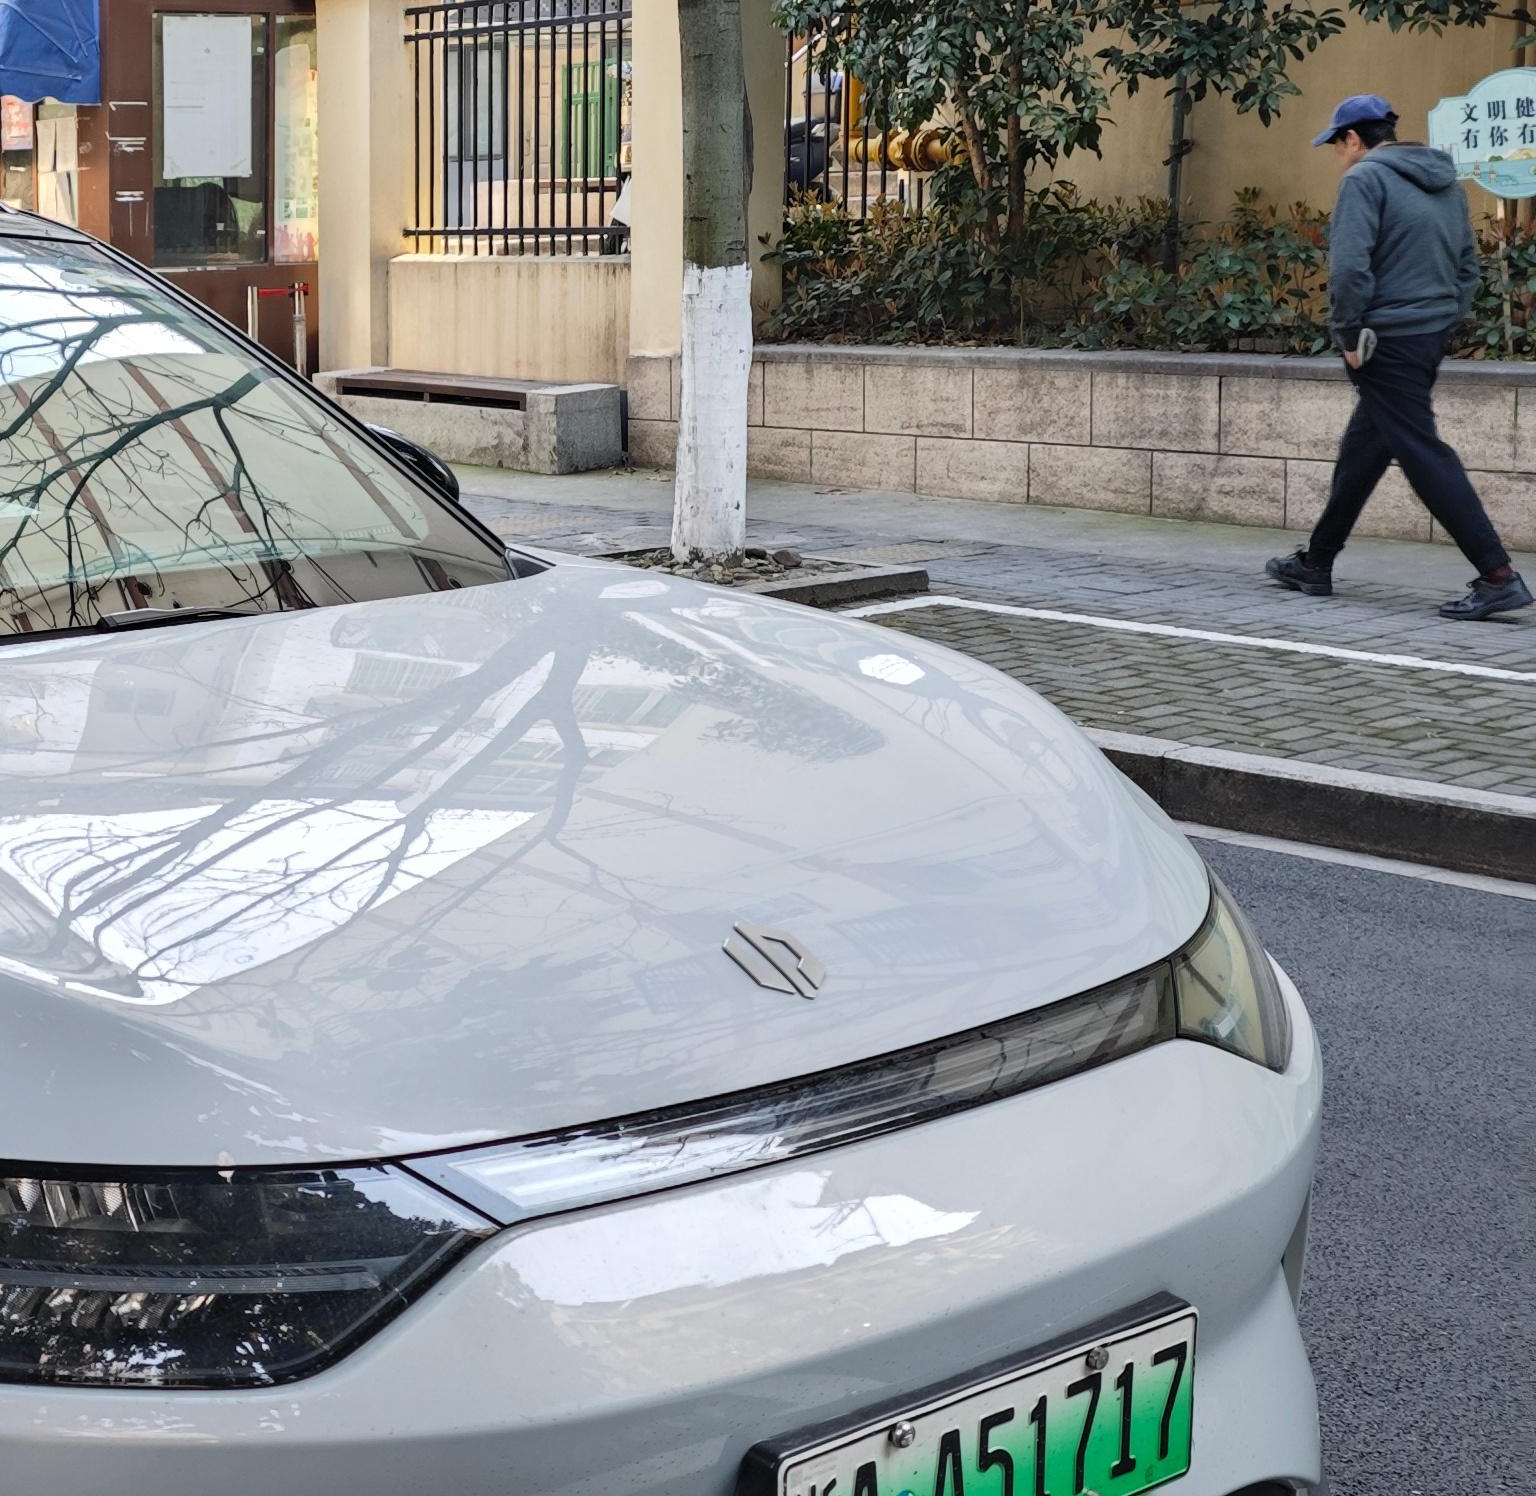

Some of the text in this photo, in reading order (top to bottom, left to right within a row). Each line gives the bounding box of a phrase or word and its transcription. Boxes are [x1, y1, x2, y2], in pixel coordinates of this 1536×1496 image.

[1460, 97, 1536, 124] 文明健
[1461, 124, 1536, 149] 有你有
